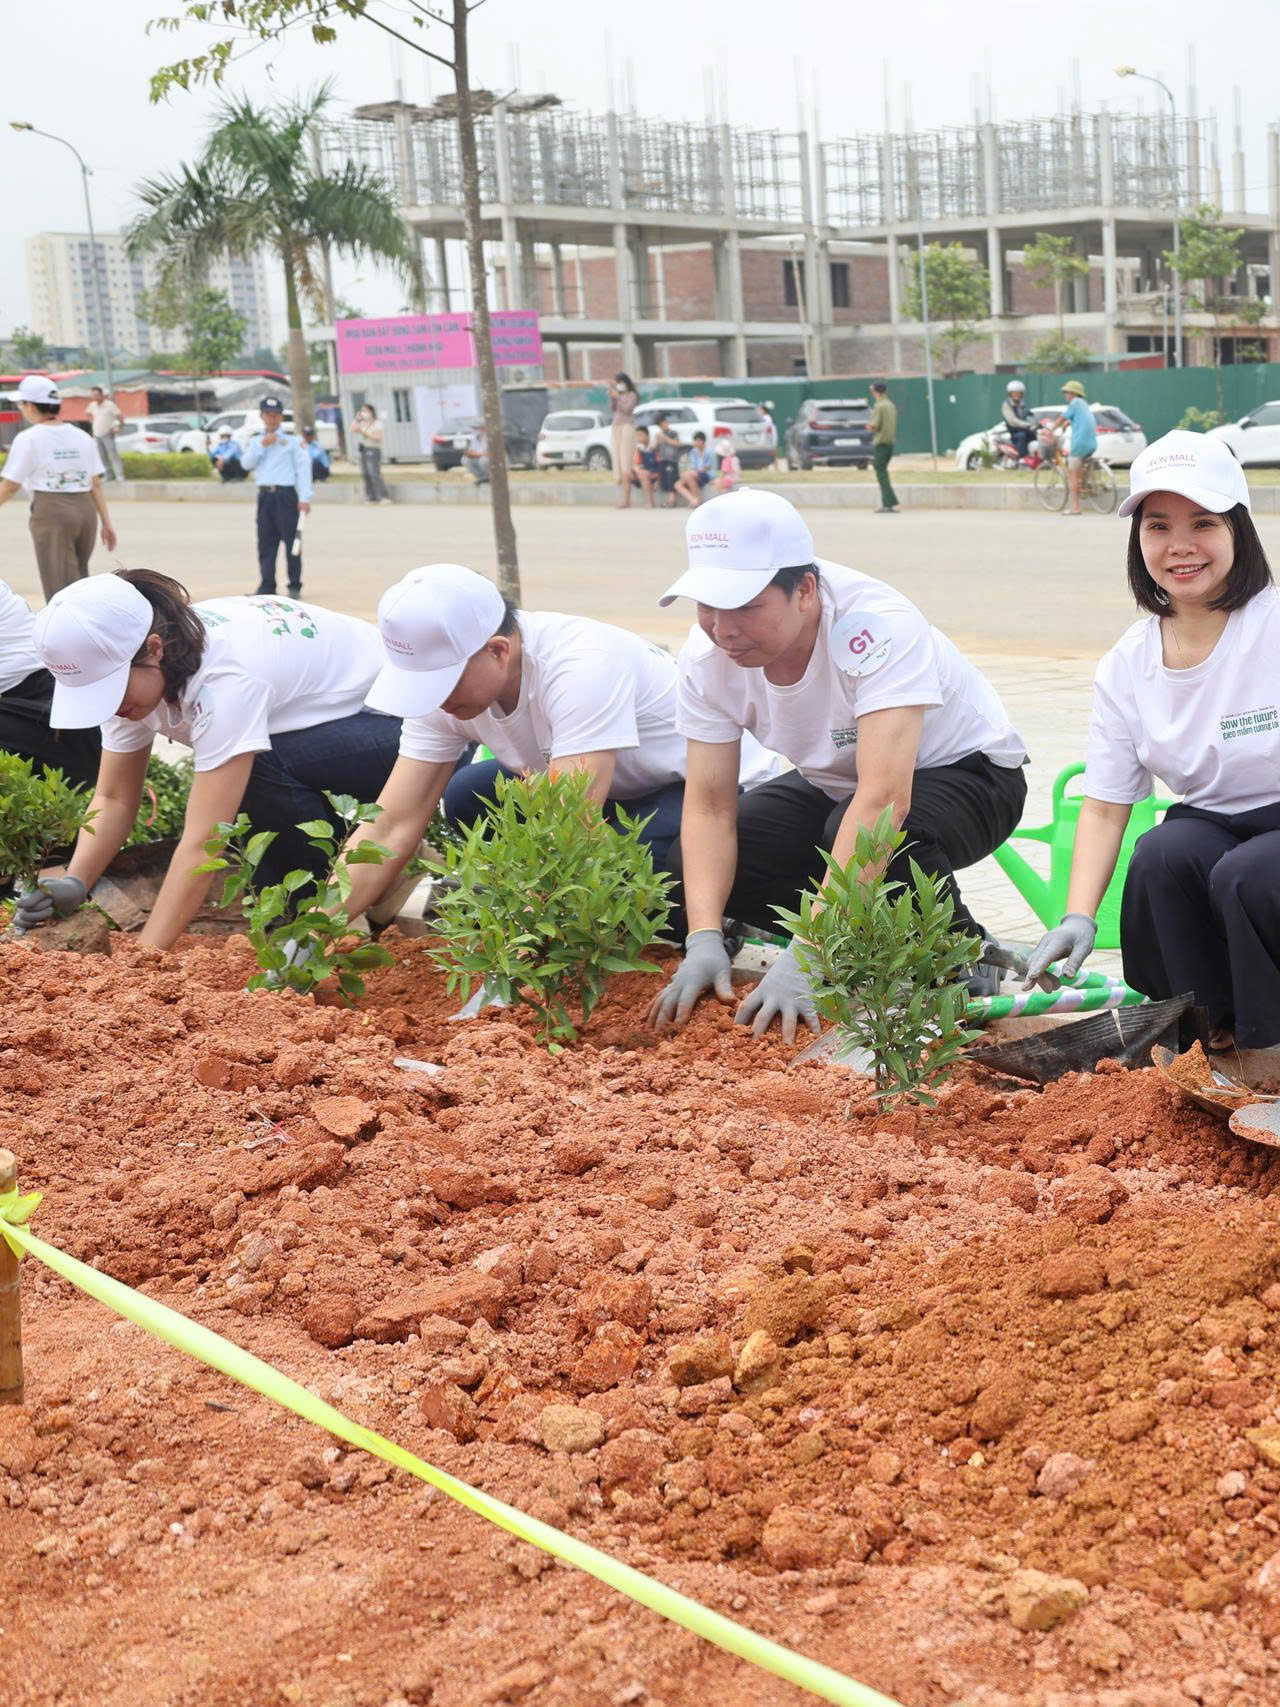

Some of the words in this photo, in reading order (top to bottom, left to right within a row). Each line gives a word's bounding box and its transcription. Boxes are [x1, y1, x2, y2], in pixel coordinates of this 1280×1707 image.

[848, 629, 875, 655] G1
[1239, 715, 1253, 727] the
[1253, 709, 1278, 724] future
